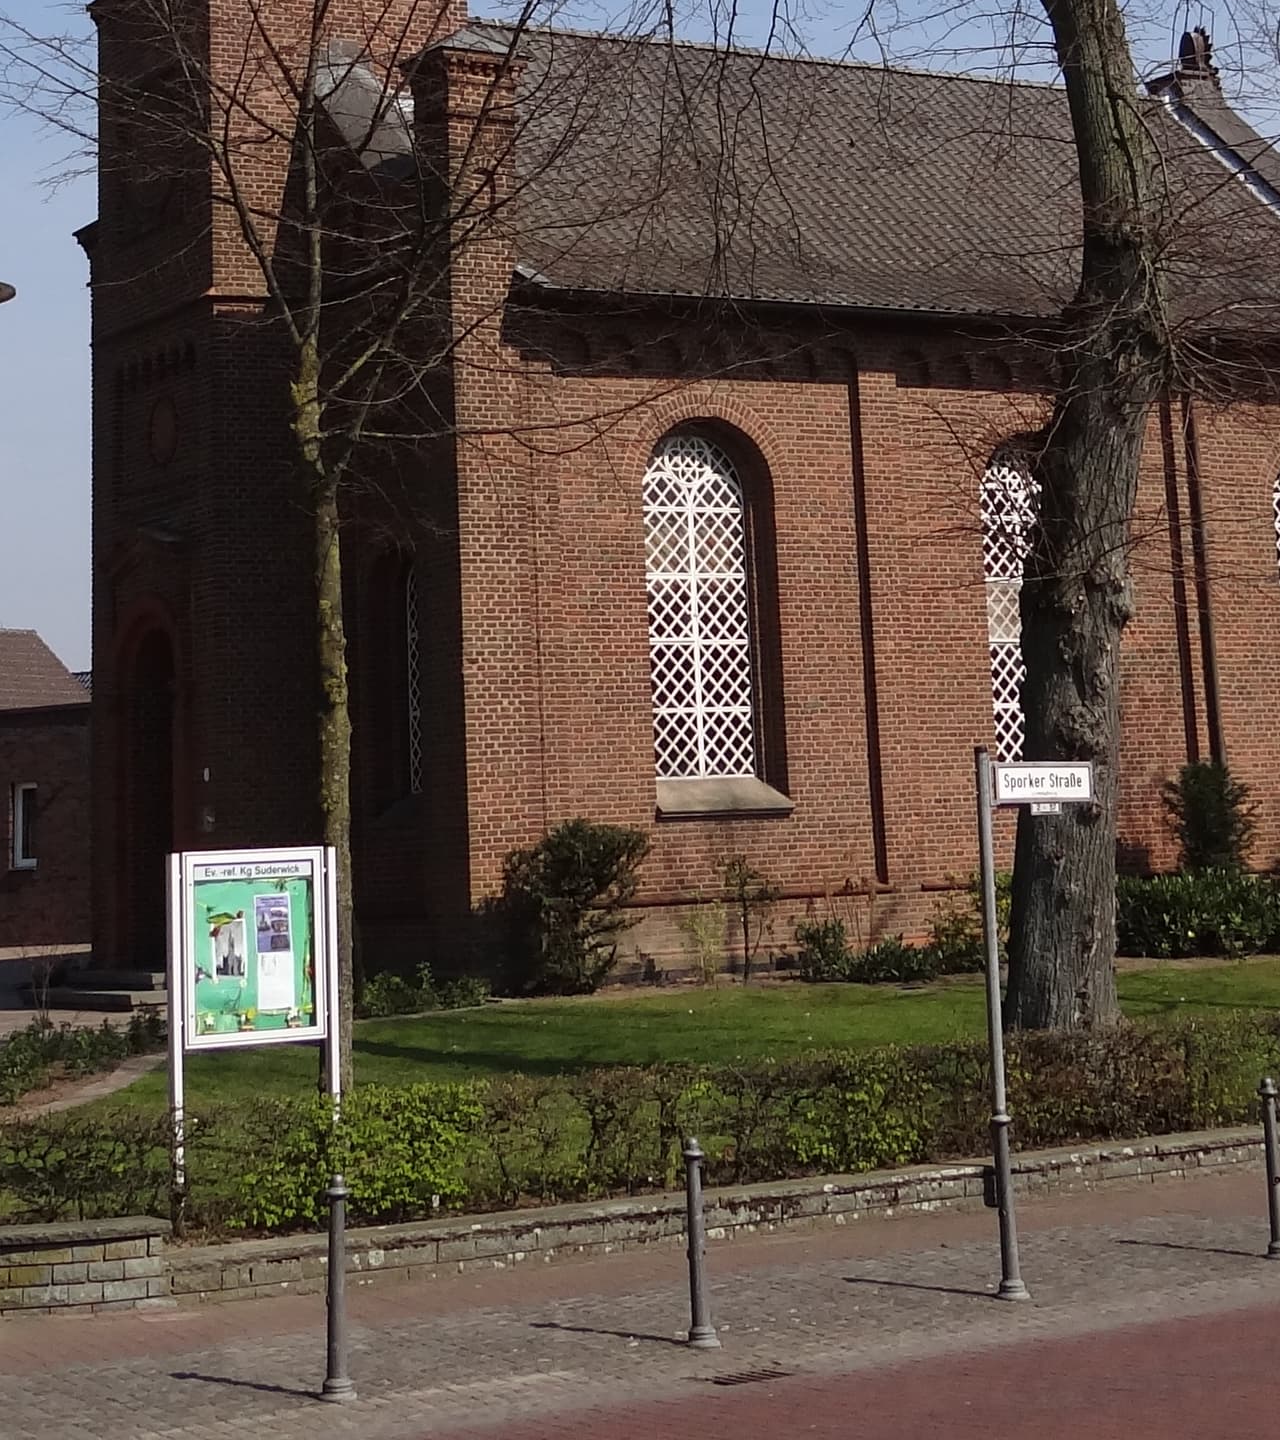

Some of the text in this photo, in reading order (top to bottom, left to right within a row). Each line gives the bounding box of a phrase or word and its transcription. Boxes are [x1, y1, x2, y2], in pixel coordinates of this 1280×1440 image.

[1004, 773, 1082, 792] Sporker Straße
[205, 867, 218, 876] Ev.
[240, 866, 252, 877] Kg
[255, 864, 300, 875] Suderwick
